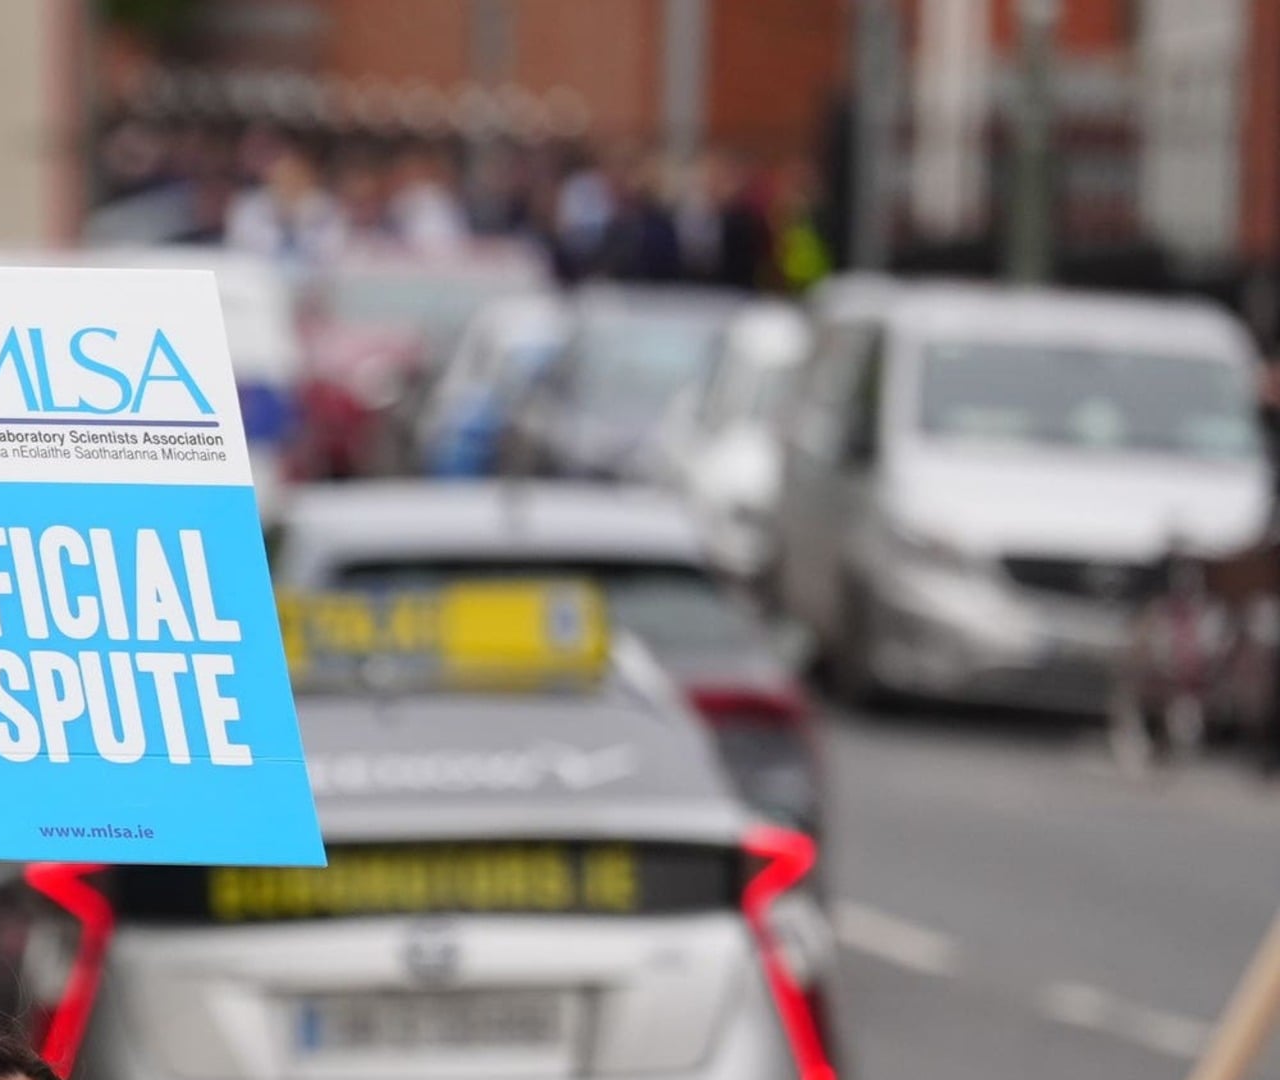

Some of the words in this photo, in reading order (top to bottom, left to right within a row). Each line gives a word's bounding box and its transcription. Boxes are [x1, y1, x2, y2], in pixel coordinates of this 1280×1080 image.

[69, 430, 138, 445] Scientists
[143, 431, 224, 446] Association
[12, 445, 71, 459] nEolaithe
[39, 823, 155, 839] www.mlsa.ie
